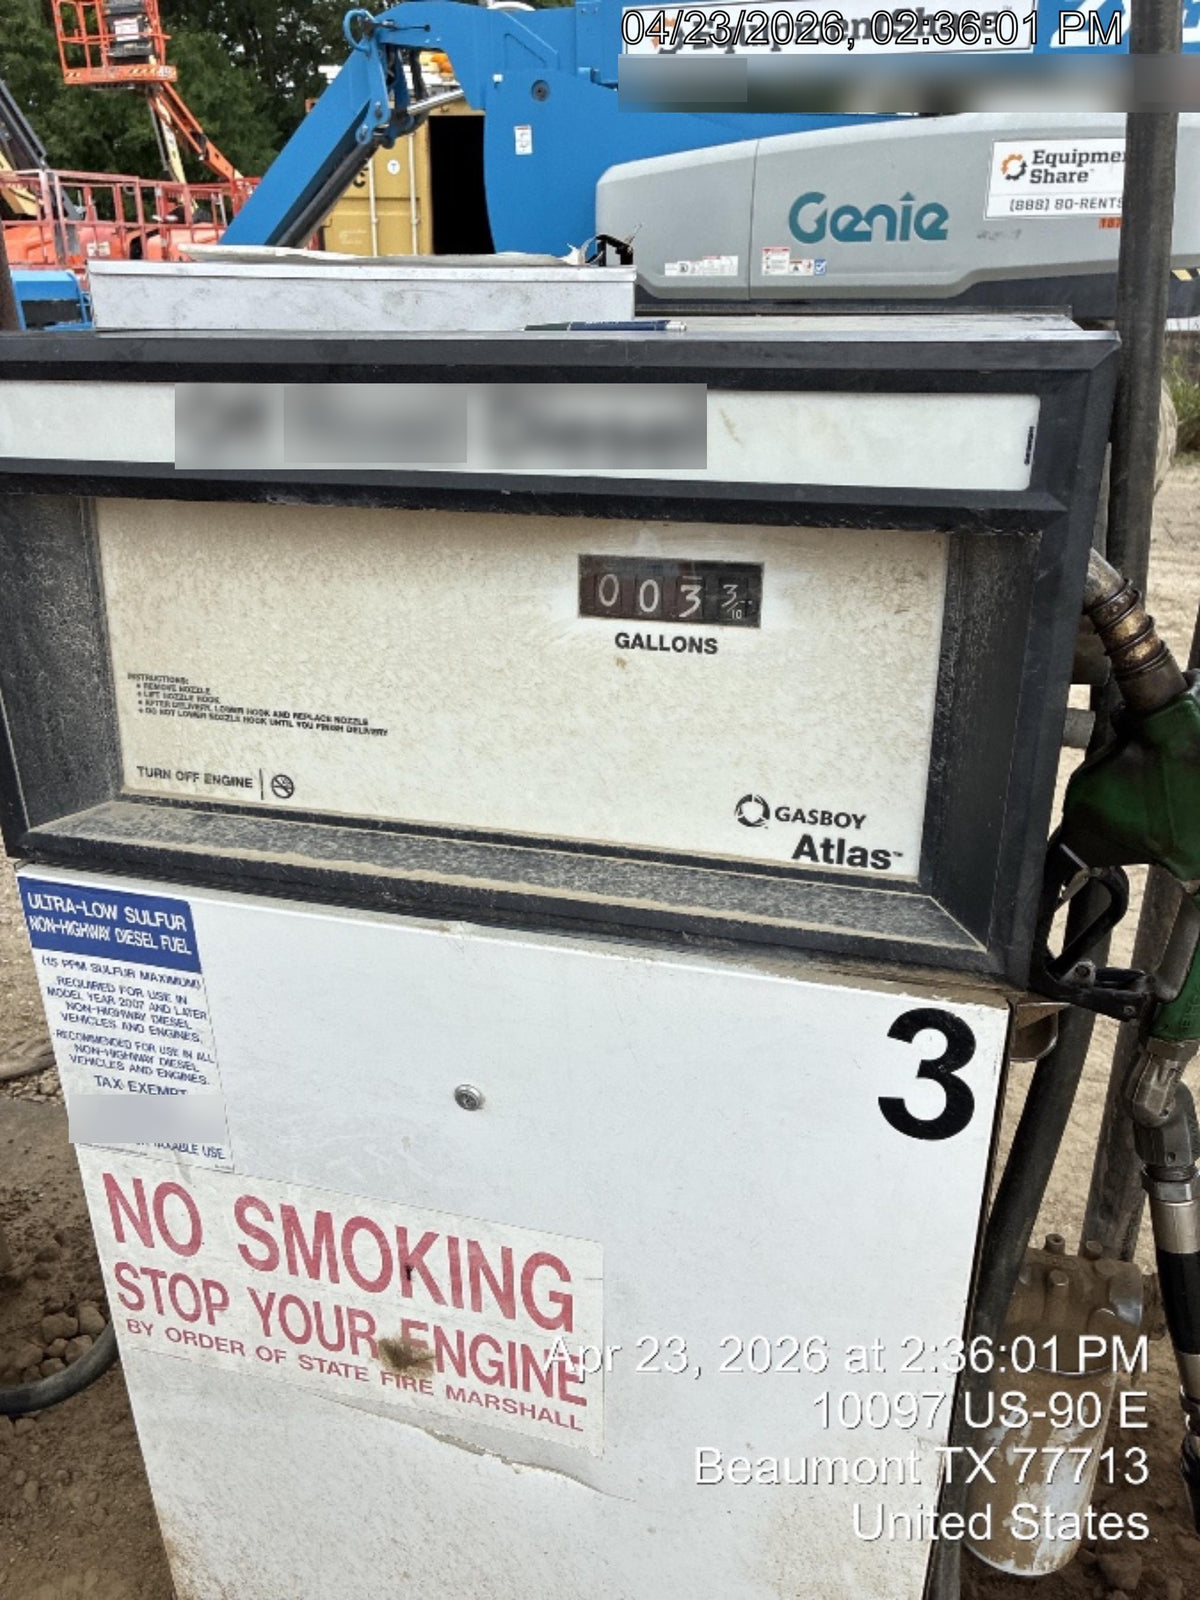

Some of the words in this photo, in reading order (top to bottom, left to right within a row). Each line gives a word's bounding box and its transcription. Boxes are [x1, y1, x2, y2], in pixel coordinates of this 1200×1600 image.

[1031, 149, 1126, 167] Equipme
[788, 191, 950, 244] Genie
[1009, 198, 1050, 212] (888)
[615, 632, 718, 654] GALLONS
[143, 682, 177, 692] REMOVE
[143, 691, 160, 699] LIFT
[163, 692, 194, 701] NOZZLE
[145, 700, 171, 708] AFTER
[214, 705, 244, 715] LOWER
[246, 707, 271, 717] HOOK
[273, 710, 290, 719] AND
[293, 712, 332, 723] REPLACE
[145, 707, 157, 715] DO
[159, 708, 175, 717] NOT
[177, 710, 207, 719] LOWER
[209, 713, 240, 723] NOZZLE
[243, 715, 267, 725] HOOK
[270, 718, 293, 728] UNTIL
[297, 721, 313, 730] YOU
[316, 723, 344, 733] FINISH
[136, 765, 171, 779] TURN
[175, 770, 200, 783] OFF
[204, 773, 253, 788] ENGINE
[774, 806, 867, 829] GASBOY
[27, 892, 118, 921] ULTRA-LOW
[124, 906, 187, 932] SULFUR
[28, 915, 111, 941] NON-HIGHWAY
[115, 928, 159, 950] DIESEL
[160, 935, 193, 955] FUEL
[41, 955, 58, 968] (15
[61, 959, 88, 972] PPM
[90, 963, 136, 979] SULFUR
[139, 970, 201, 991] MAXIMUM)
[47, 986, 83, 1000] MODEL
[88, 992, 116, 1005] YEAR
[118, 996, 145, 1009] 2007
[149, 1002, 171, 1014] AND
[173, 1006, 208, 1020] LATER
[56, 976, 116, 993] REQUIRED
[119, 984, 145, 998] FOR
[147, 990, 173, 1003] USE
[175, 995, 188, 1005] IN
[61, 1012, 117, 1029] VEHICLES
[122, 1021, 145, 1034] AND
[65, 1001, 146, 1021] NON-HIGHWAY
[150, 1014, 193, 1030] DIESEL
[55, 1029, 131, 1050] RECOMMENDED
[134, 1041, 156, 1053] FOR
[159, 1046, 180, 1057] USE
[182, 1049, 193, 1059] IN
[196, 1052, 215, 1064] ALL
[74, 1043, 155, 1065] NON-HIGHWAY
[159, 1057, 200, 1072] DIESEL
[69, 1053, 125, 1071] VEHICLES
[129, 1064, 153, 1076] AND
[878, 1007, 977, 1140] 3
[94, 1074, 123, 1090] TAX
[202, 1144, 226, 1160] USE
[102, 1173, 203, 1258] NO
[234, 1194, 574, 1333] SMOKING
[114, 1262, 230, 1326] STOP
[246, 1286, 381, 1359] YOUR
[400, 1318, 588, 1407] ENGINE
[126, 1319, 154, 1336] BY
[165, 1327, 247, 1357] ORDER
[255, 1345, 288, 1364] OF
[298, 1354, 370, 1382] STATE
[380, 1370, 434, 1396] FIRE
[446, 1384, 584, 1432] MARSHALL
